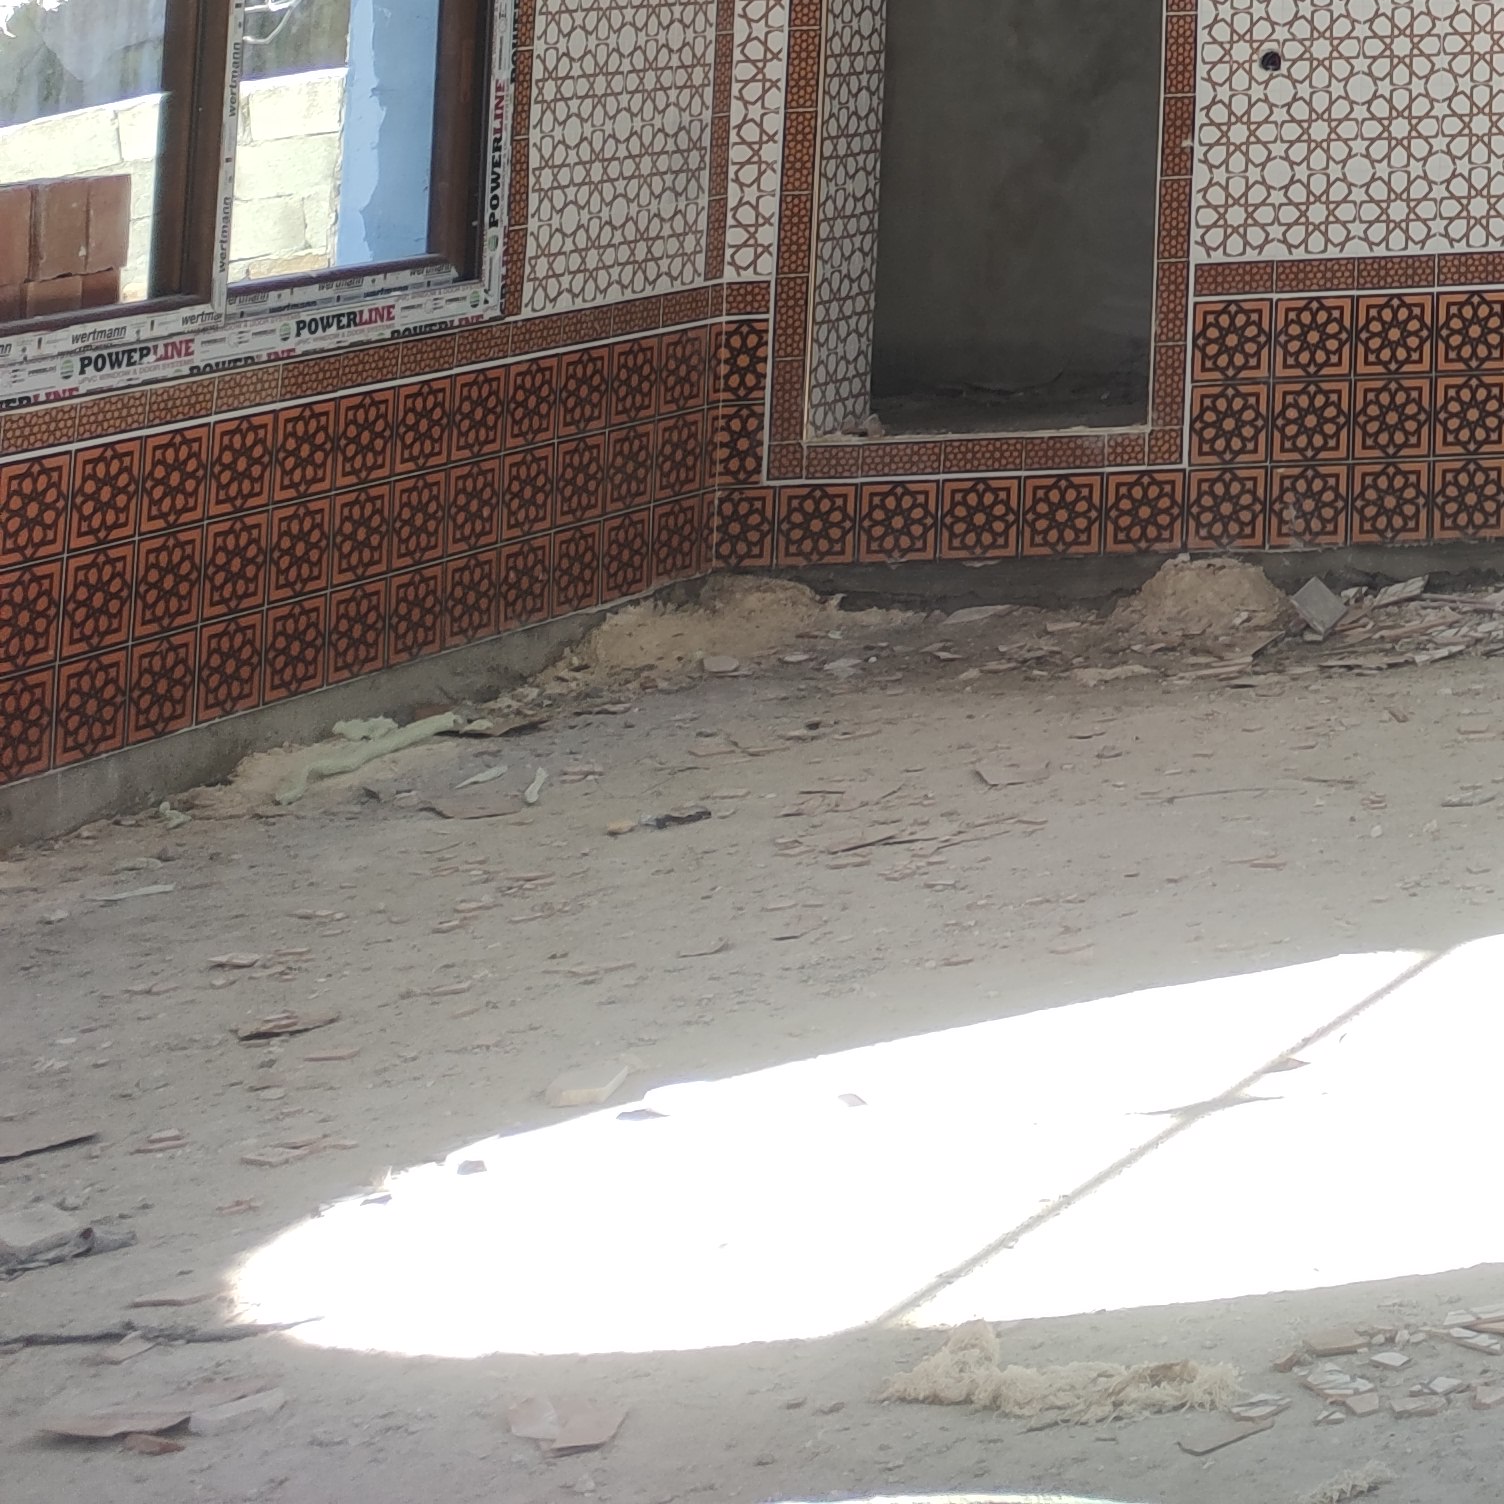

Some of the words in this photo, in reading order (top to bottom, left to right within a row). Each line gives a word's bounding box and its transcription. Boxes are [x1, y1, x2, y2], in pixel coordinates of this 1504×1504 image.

[228, 41, 242, 117] wertmann
[488, 78, 506, 230] POWERLINE
[218, 195, 232, 275] wertmann
[71, 325, 127, 345] wertmann
[295, 304, 397, 338] POWERLINE
